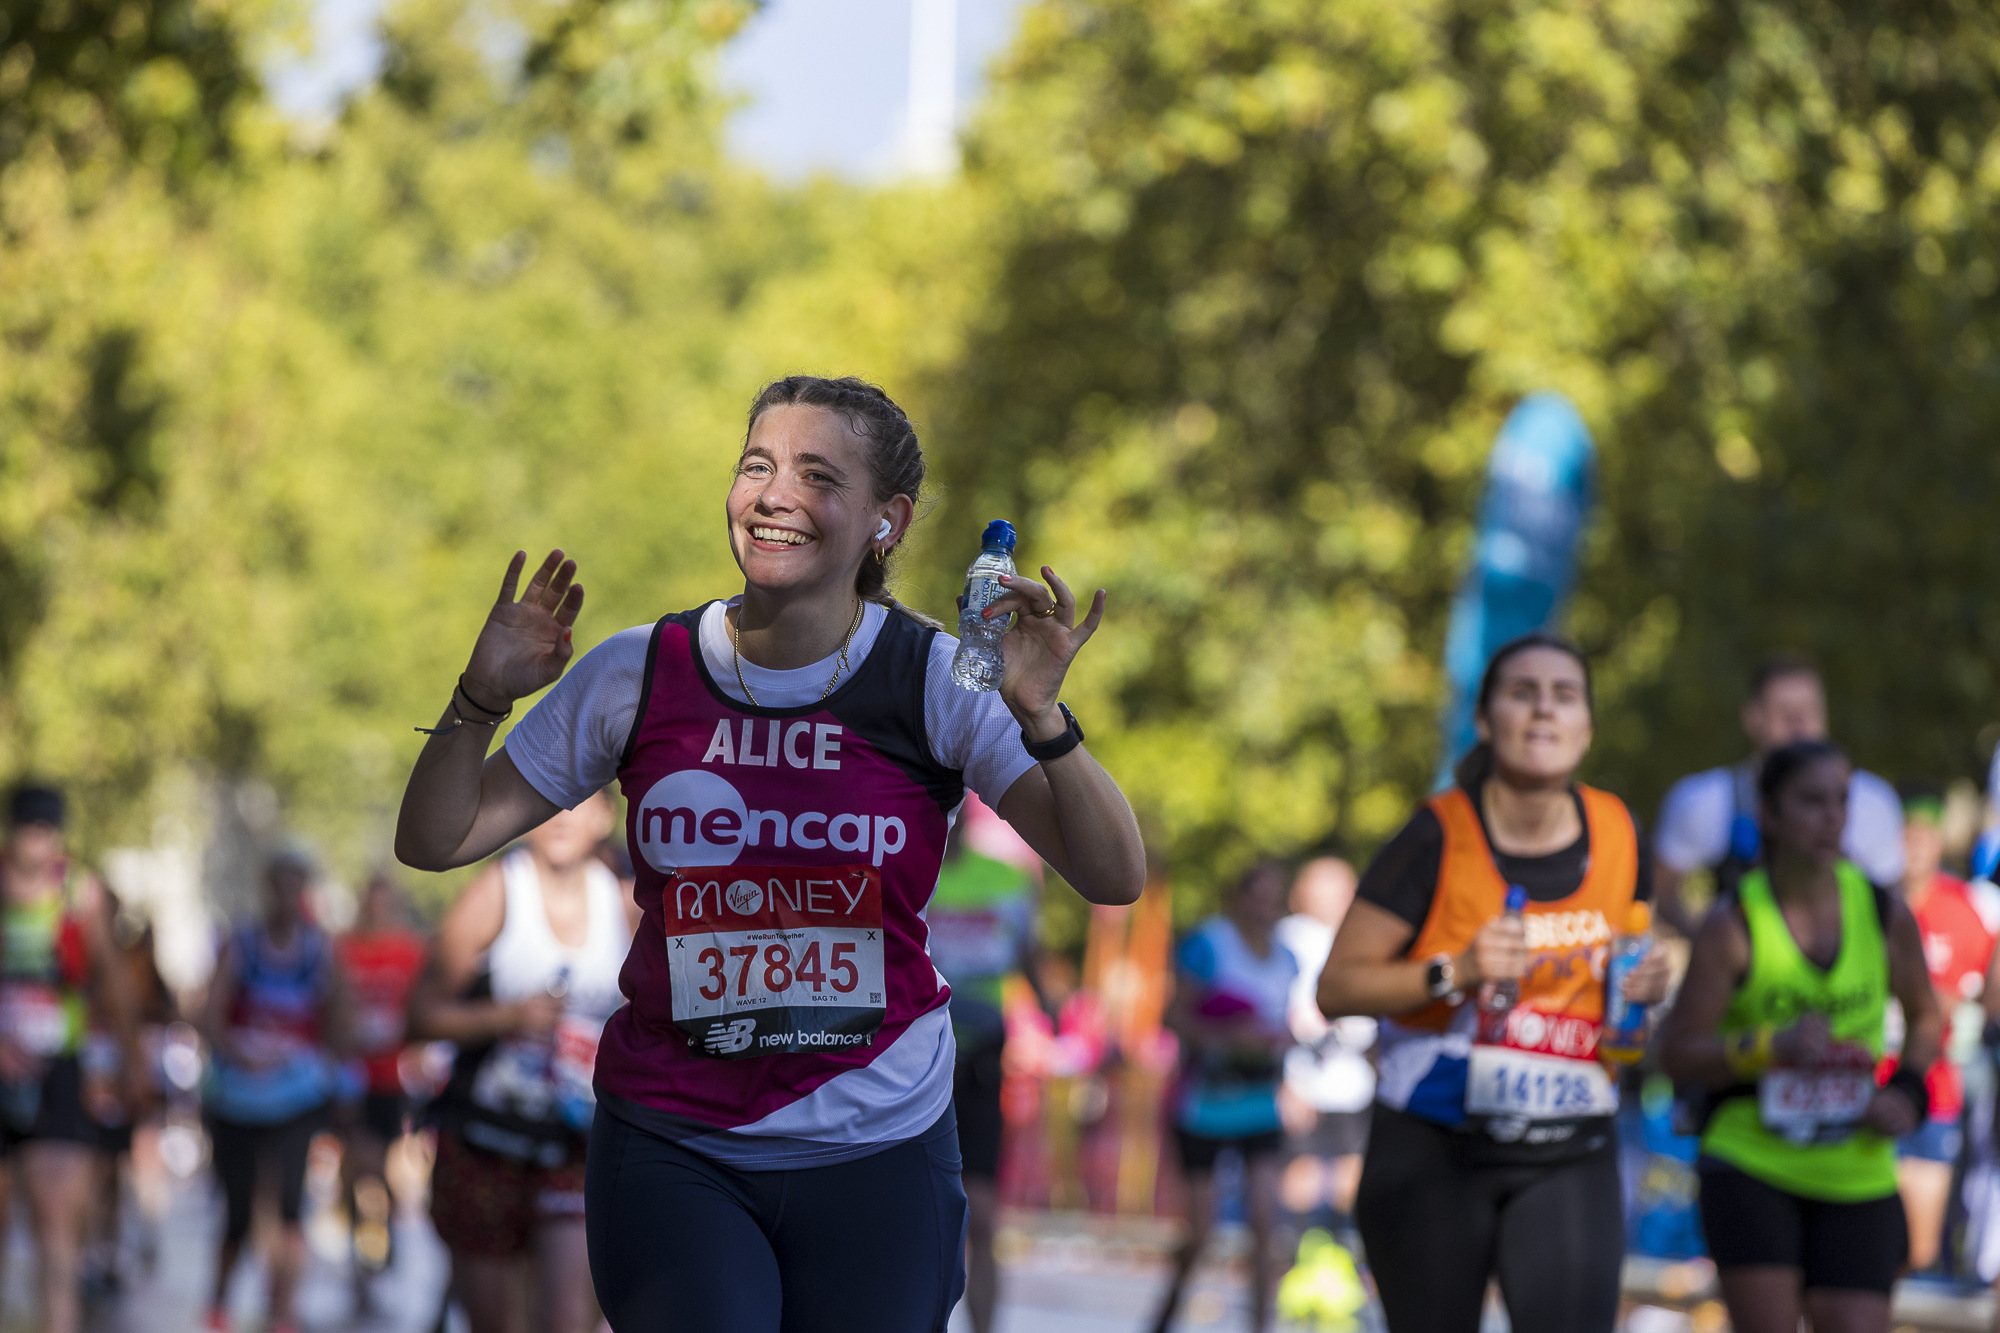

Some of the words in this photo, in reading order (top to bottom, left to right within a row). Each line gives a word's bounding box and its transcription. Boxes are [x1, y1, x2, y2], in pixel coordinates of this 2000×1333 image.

[979, 576, 991, 608] BUXTON
[702, 718, 843, 770] ALICE
[641, 805, 907, 867] mencap
[676, 878, 868, 919] MONEY
[728, 885, 760, 910] Virgin
[675, 938, 685, 949] X
[747, 932, 805, 941] #WeRunTogether
[866, 931, 877, 941] X
[697, 941, 859, 1001] 37845
[736, 998, 757, 1006] WAVE
[704, 1018, 756, 1054] NB
[759, 1032, 793, 1048] new
[797, 1030, 862, 1046] balance
